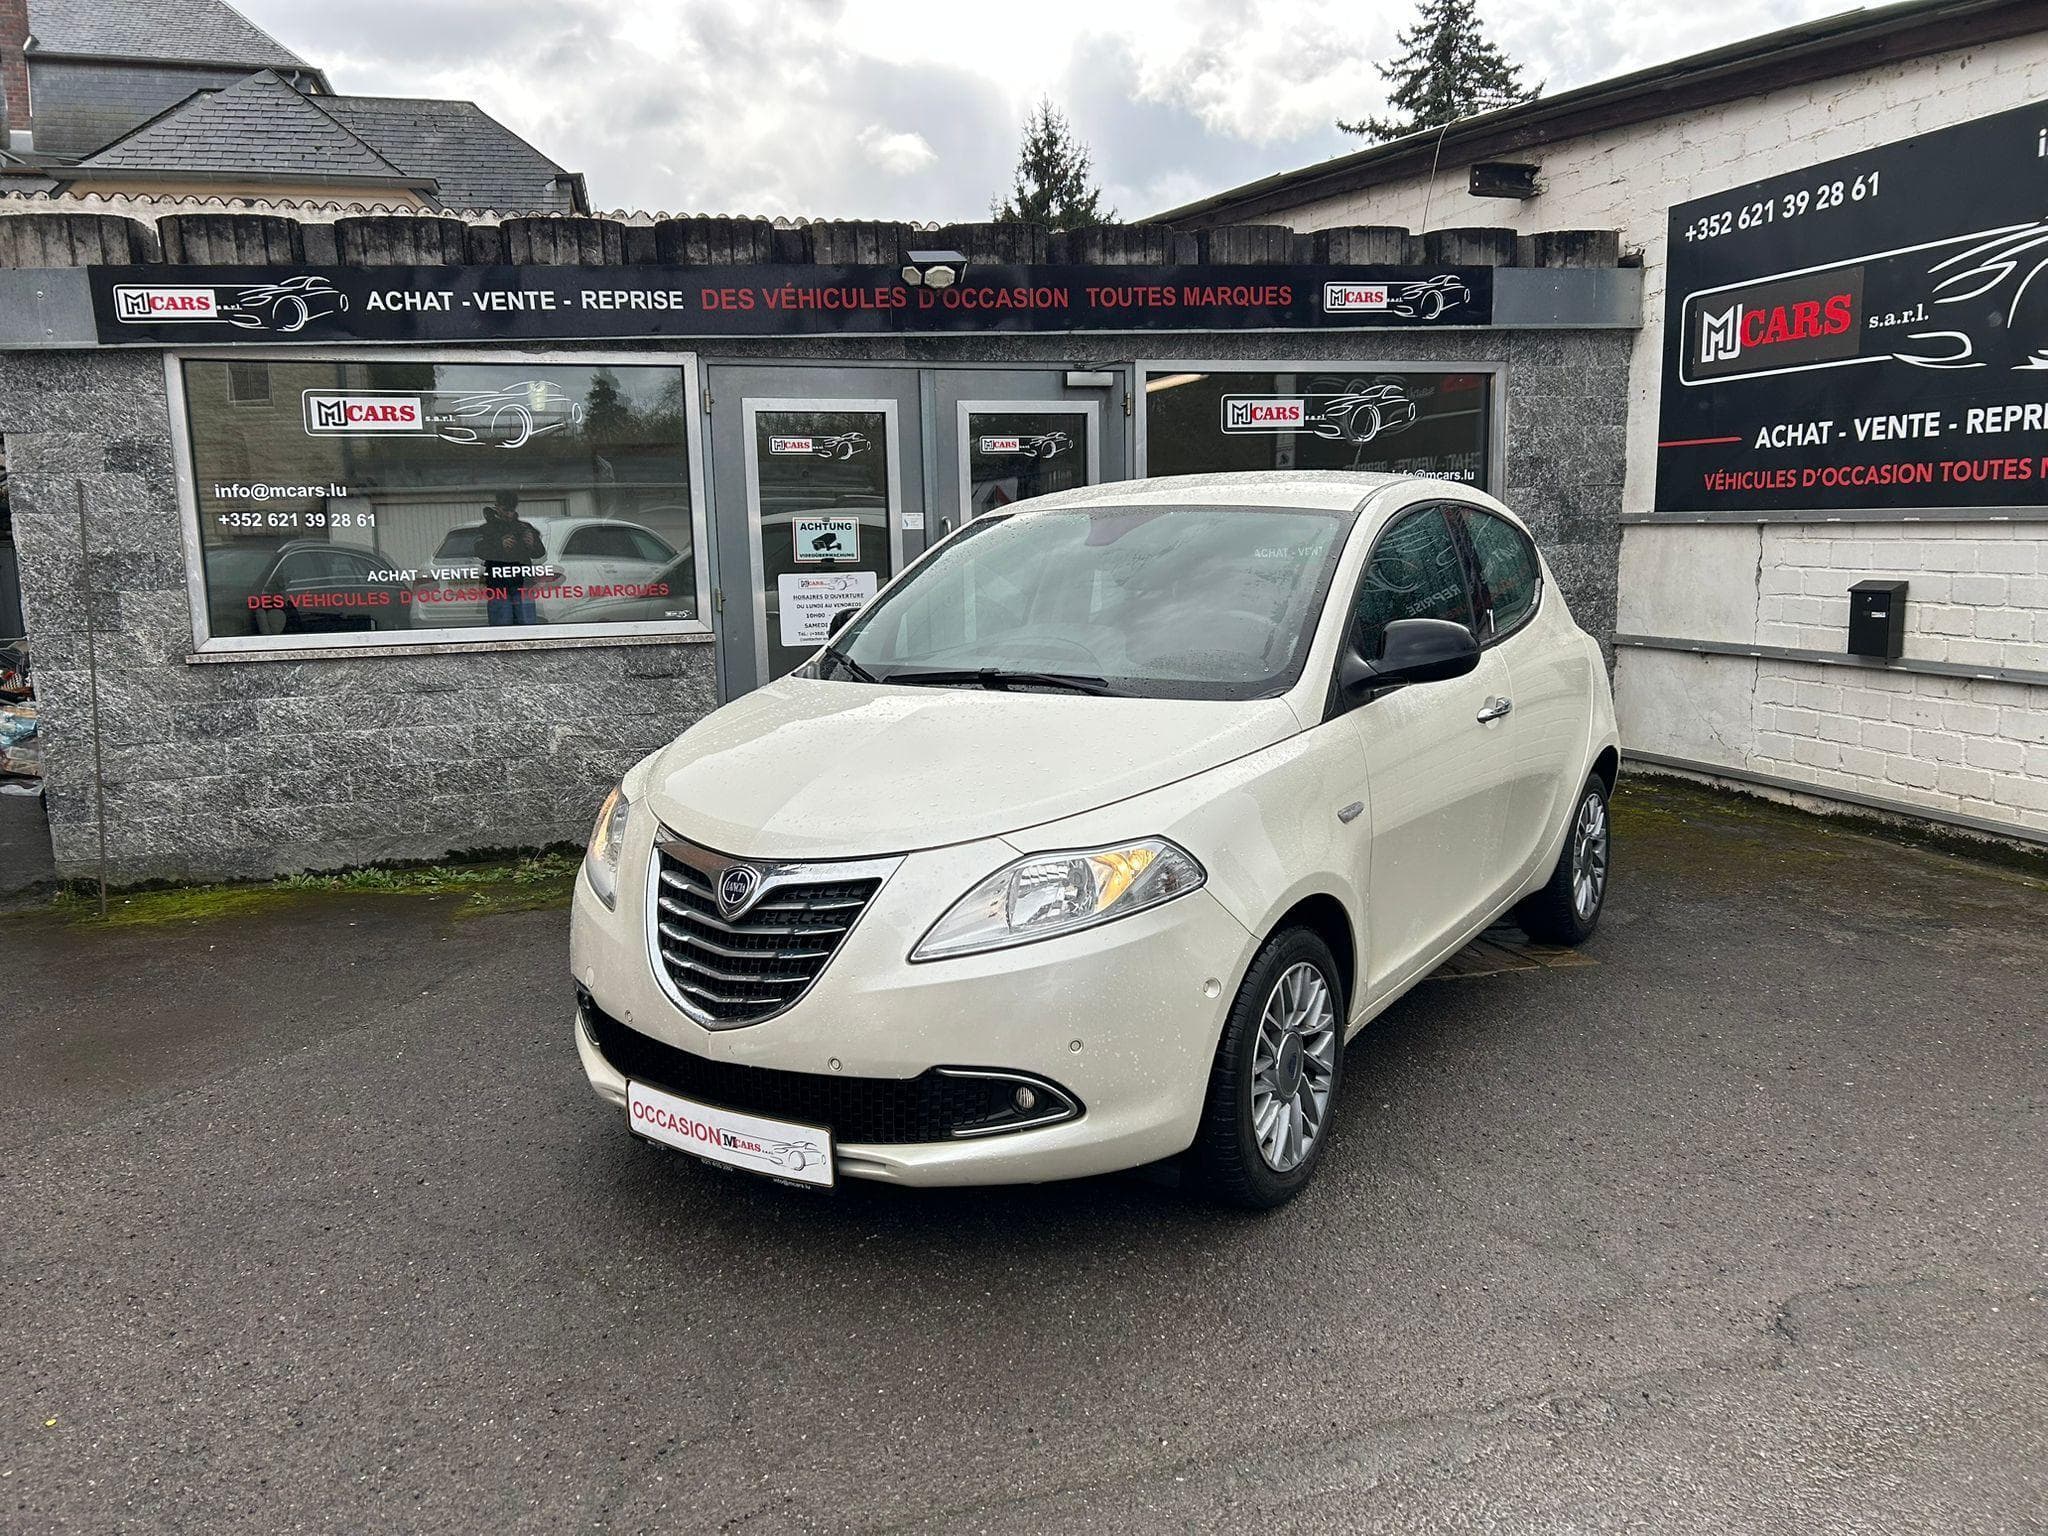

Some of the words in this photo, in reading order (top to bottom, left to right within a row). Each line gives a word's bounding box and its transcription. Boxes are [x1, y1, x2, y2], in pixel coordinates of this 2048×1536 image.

[2038, 128, 2048, 157] i
[1685, 211, 1732, 242] +352
[1738, 199, 1775, 230] 621
[1782, 190, 1810, 219] 39
[1815, 181, 1845, 211] 28
[1851, 171, 1880, 201] 61
[366, 290, 454, 311] ACHAT
[580, 290, 684, 310] REPRISE
[701, 288, 755, 311] DES
[762, 282, 907, 310] VÉHICULES
[918, 286, 1069, 310] D'OCCASION
[1086, 285, 1177, 308] TOUTES
[1183, 285, 1293, 308] MARQUES
[1868, 303, 1930, 329] s.a.r.l.
[1754, 420, 1833, 449] ACHAT
[1853, 411, 1941, 442] VENTE
[1703, 468, 1797, 491] VÉHICULES
[1802, 463, 1933, 488] D'OCCASION
[1939, 457, 2033, 482] TOUTES
[214, 483, 348, 501] info@mcars.lu
[218, 512, 263, 527] +352
[268, 512, 299, 527] 621
[305, 512, 326, 527] 39
[330, 512, 351, 527] 28
[356, 512, 376, 527] 61
[800, 522, 852, 531] ACHTUNG
[367, 570, 418, 582] ACHAT
[430, 568, 479, 580] VENTE
[492, 565, 555, 579] REPRISE
[247, 594, 286, 610] DES
[289, 590, 390, 608] VÉHICULES
[399, 586, 508, 605] D'OCCASION
[516, 585, 584, 600] TOUTES
[588, 583, 670, 598] MARQUES
[633, 1101, 721, 1146] OCCASION
